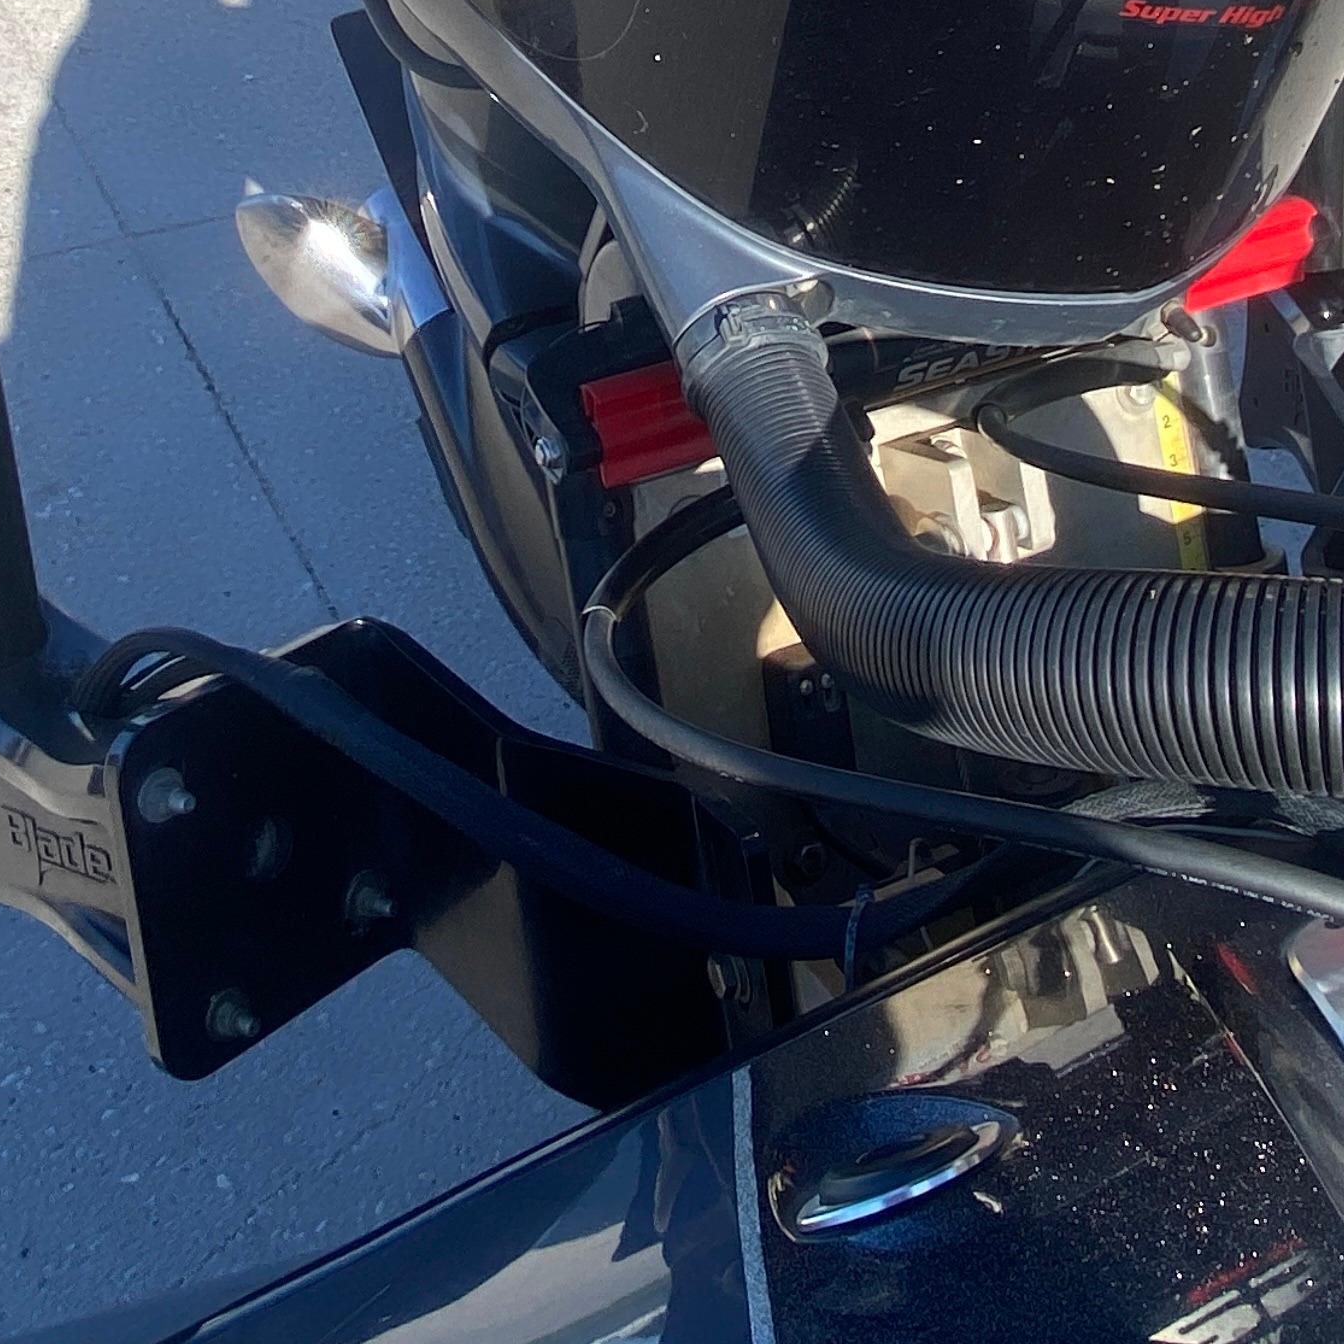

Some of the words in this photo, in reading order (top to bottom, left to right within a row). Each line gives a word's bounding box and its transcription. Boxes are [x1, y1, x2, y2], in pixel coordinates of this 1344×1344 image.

[1119, 0, 1217, 25] Super
[1219, 3, 1286, 28] High
[893, 351, 981, 392] SEA
[1161, 414, 1172, 429] 2
[1168, 454, 1179, 468] 3
[1182, 532, 1193, 546] 5
[1, 805, 117, 885] Blade
